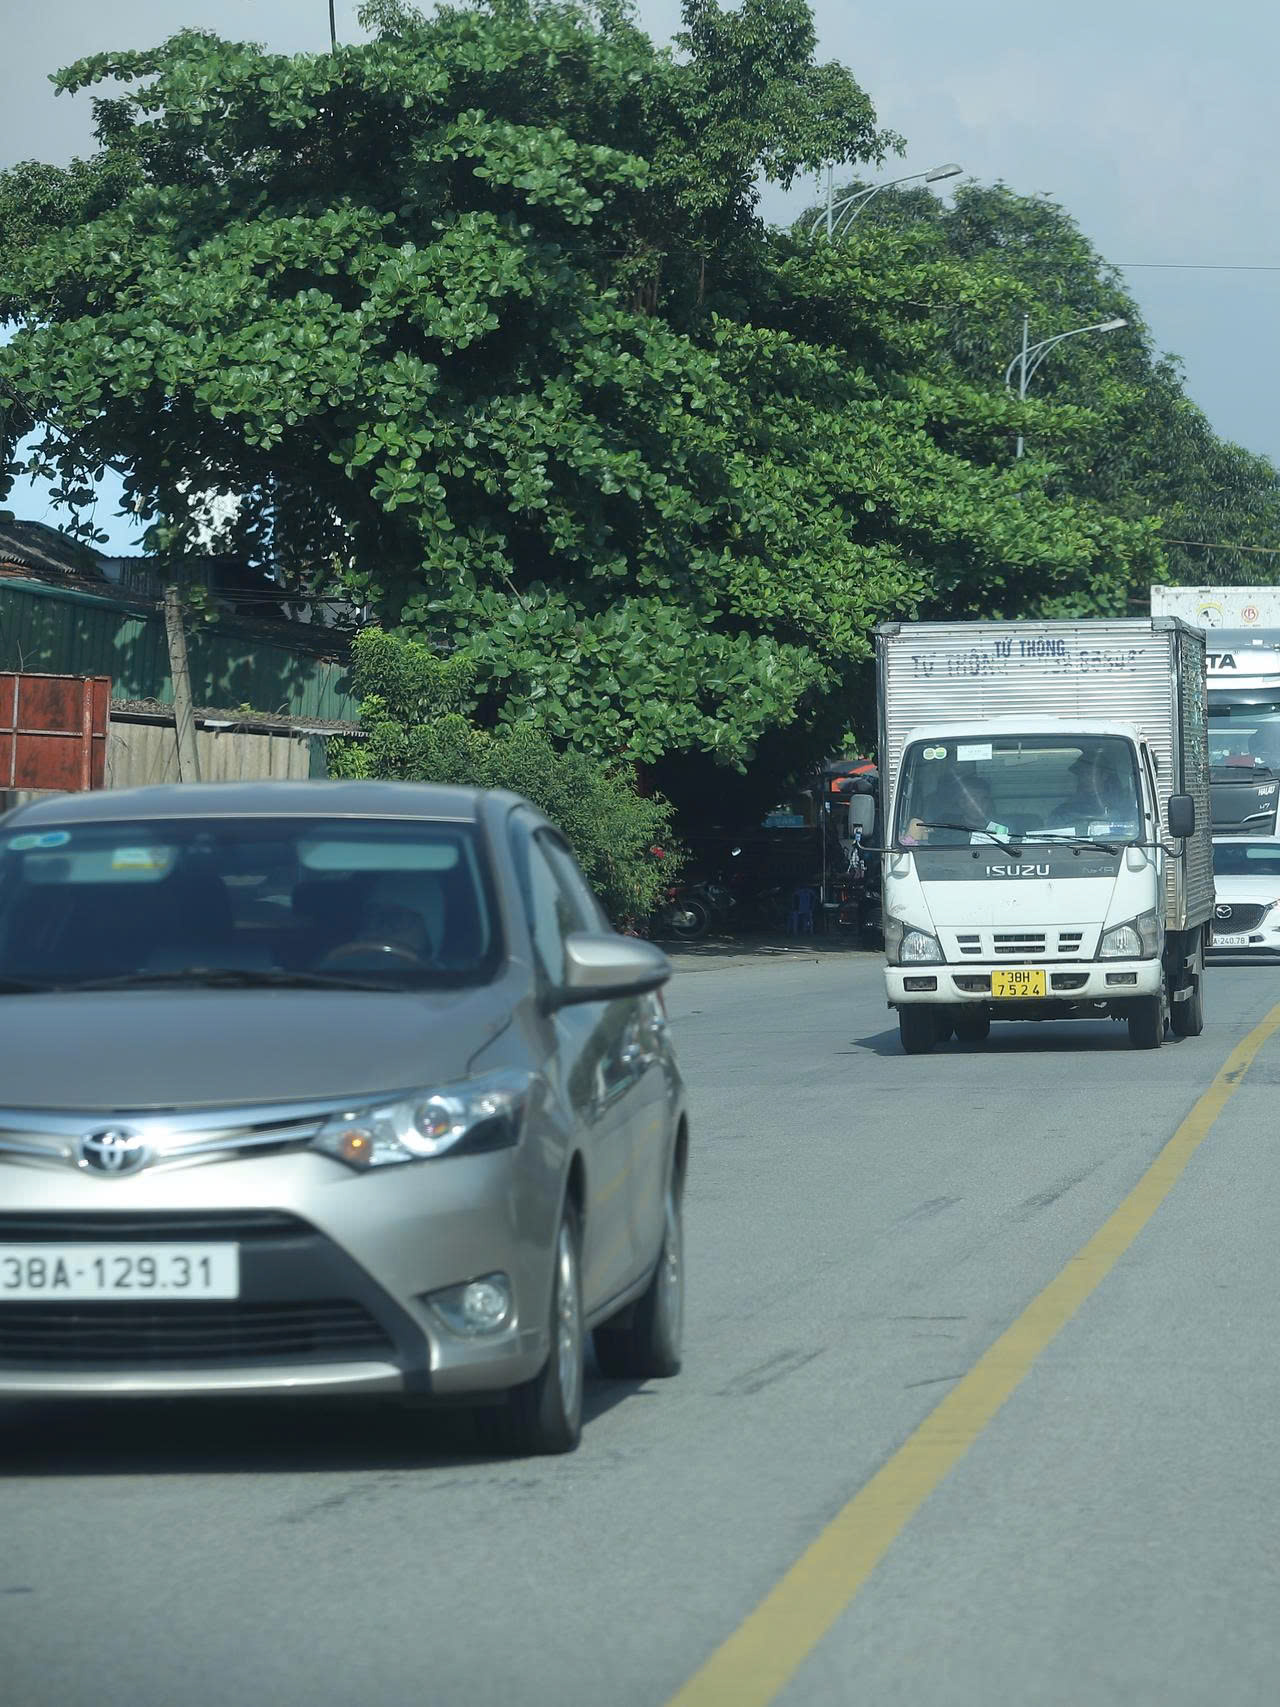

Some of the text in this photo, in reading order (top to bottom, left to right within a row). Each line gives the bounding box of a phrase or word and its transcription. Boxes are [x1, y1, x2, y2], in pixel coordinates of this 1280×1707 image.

[1019, 636, 1066, 658] THÔNG
[986, 864, 1050, 876] ISUZU
[1213, 937, 1246, 945] A-240.78
[1007, 971, 1030, 983] 38H
[3, 1256, 212, 1289] 38A-129.31
